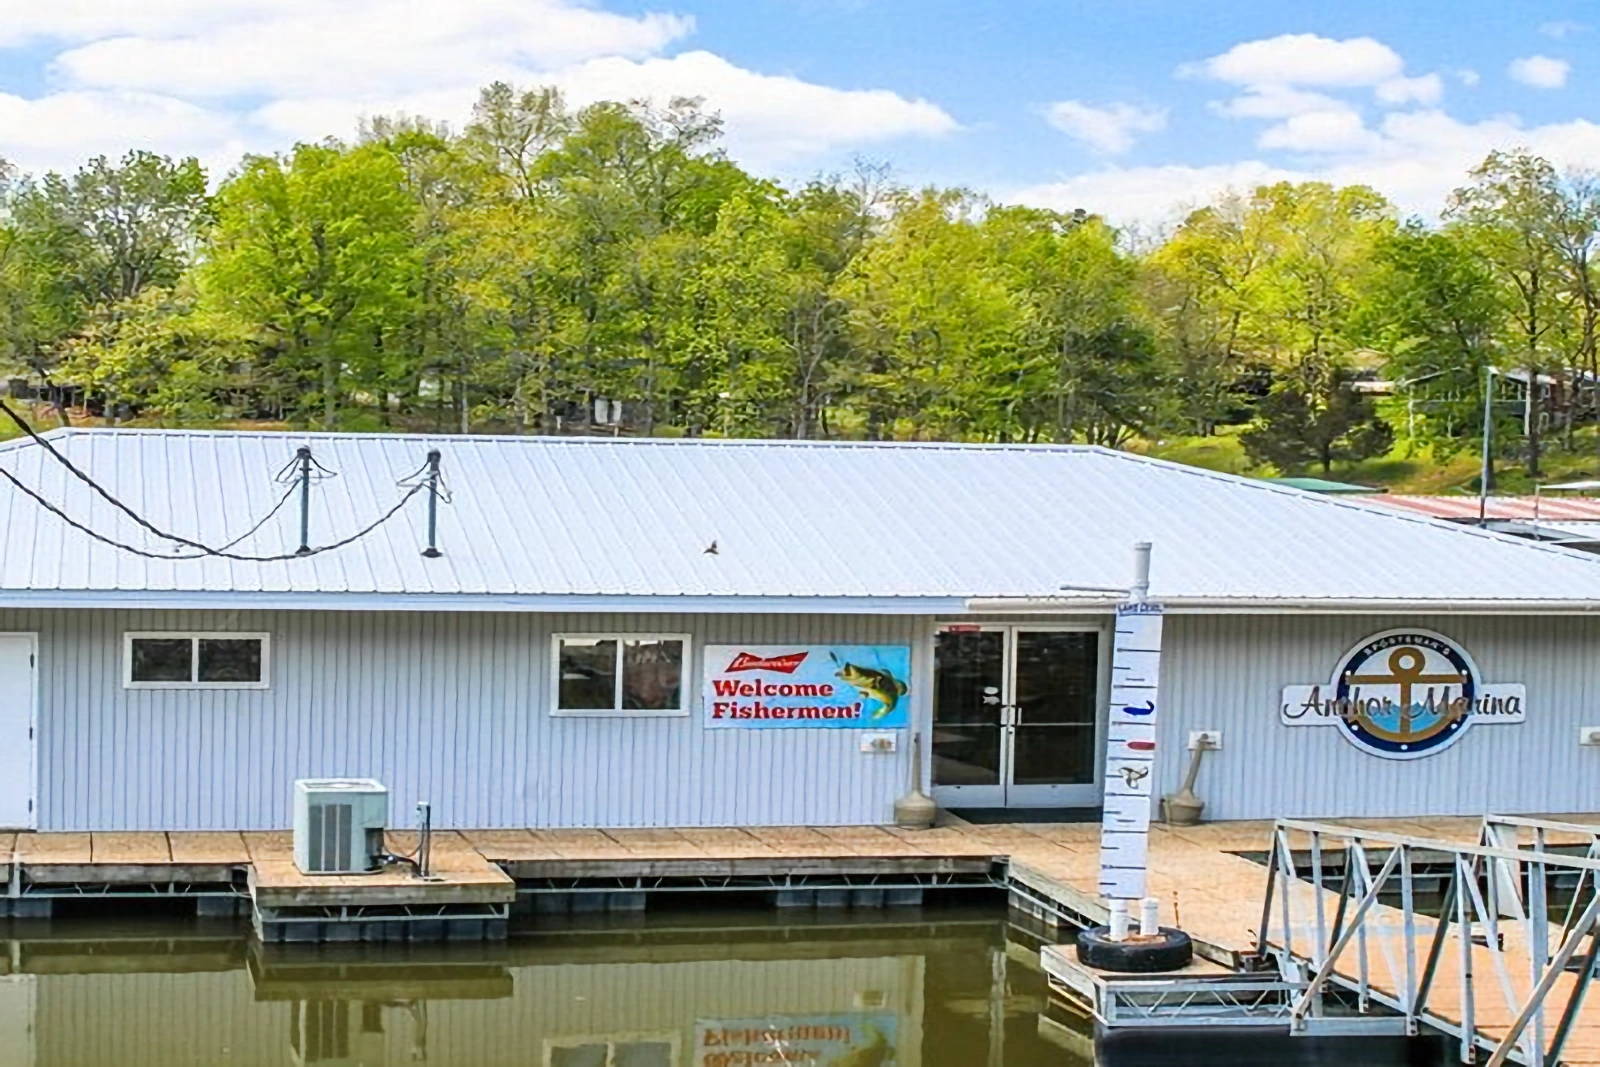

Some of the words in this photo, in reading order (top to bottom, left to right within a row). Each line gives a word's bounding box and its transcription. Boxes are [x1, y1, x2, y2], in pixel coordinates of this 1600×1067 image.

[712, 679, 834, 697] Welcome
[712, 702, 862, 718] Fishermen!
[1402, 686, 1522, 718] Marina
